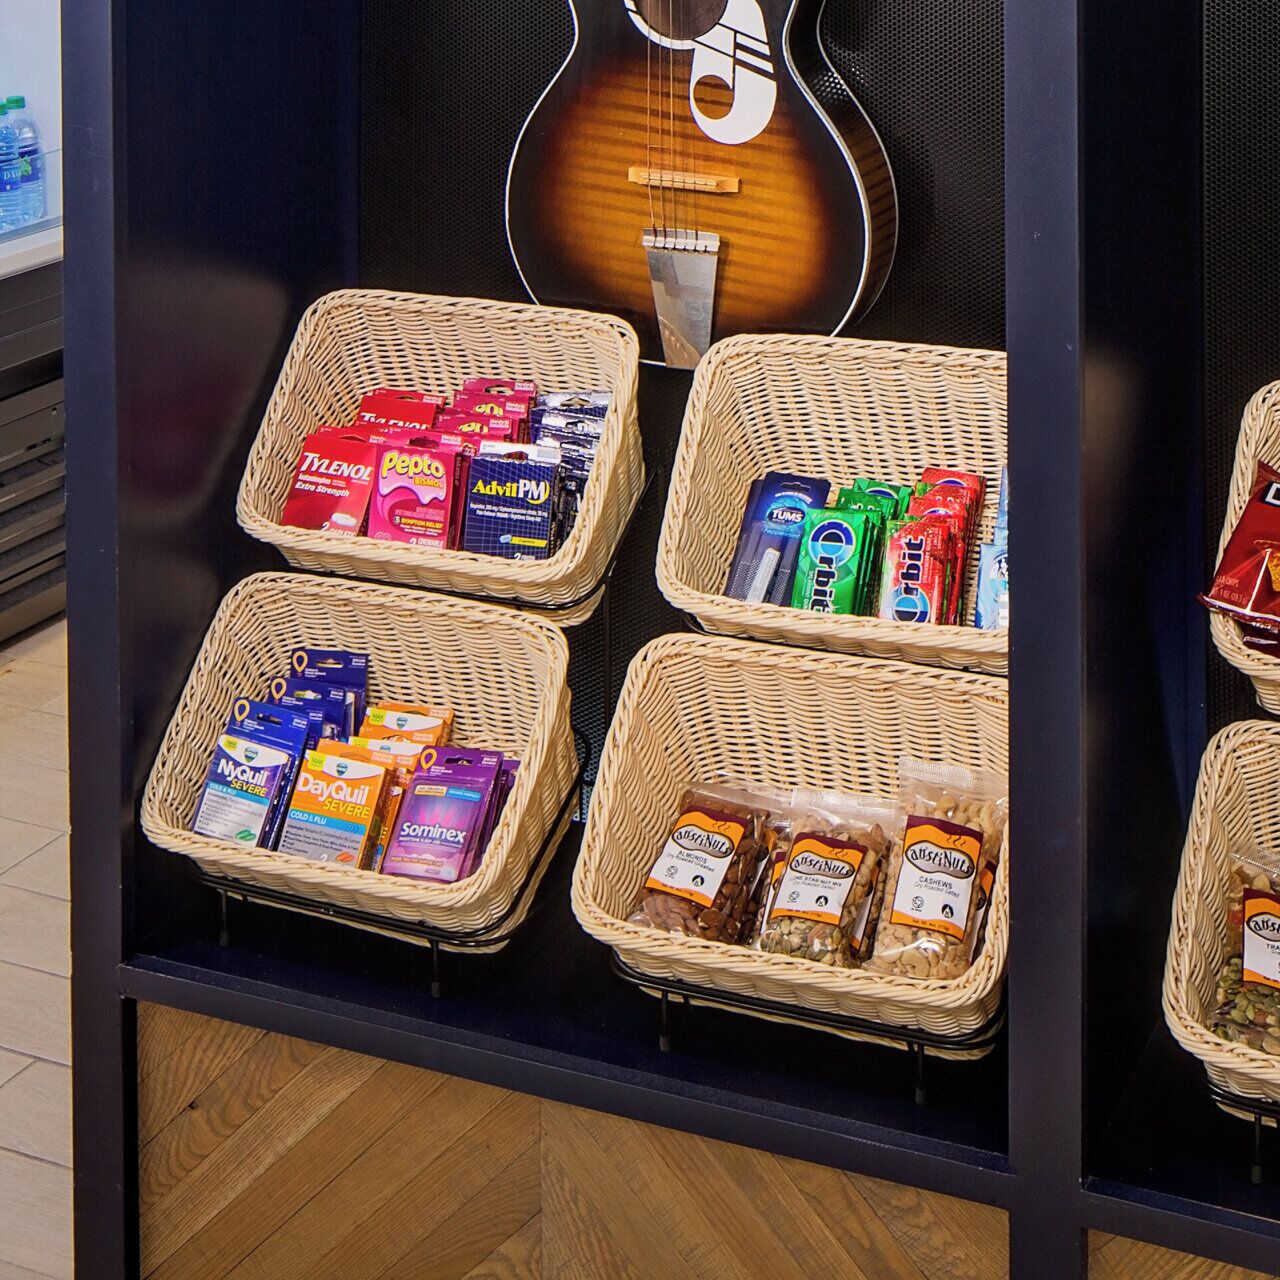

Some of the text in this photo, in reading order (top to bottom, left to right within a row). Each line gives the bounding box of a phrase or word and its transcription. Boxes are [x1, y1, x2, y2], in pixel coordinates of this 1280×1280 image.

[300, 452, 375, 481] TYLENOL
[381, 452, 445, 479] Pepto
[295, 482, 350, 498] Extra Strength
[414, 477, 443, 488] BISMOL
[472, 479, 545, 500] Advil PM
[772, 510, 803, 523] TUMS
[217, 758, 268, 789] NyQuil
[230, 779, 268, 798] SEVERE
[297, 772, 370, 805] DayQuil
[290, 810, 309, 821] COLD
[314, 816, 327, 825] FLU
[323, 798, 371, 819] SEVERE
[400, 822, 467, 843] Sominex
[919, 876, 953, 890] CASHEWS
